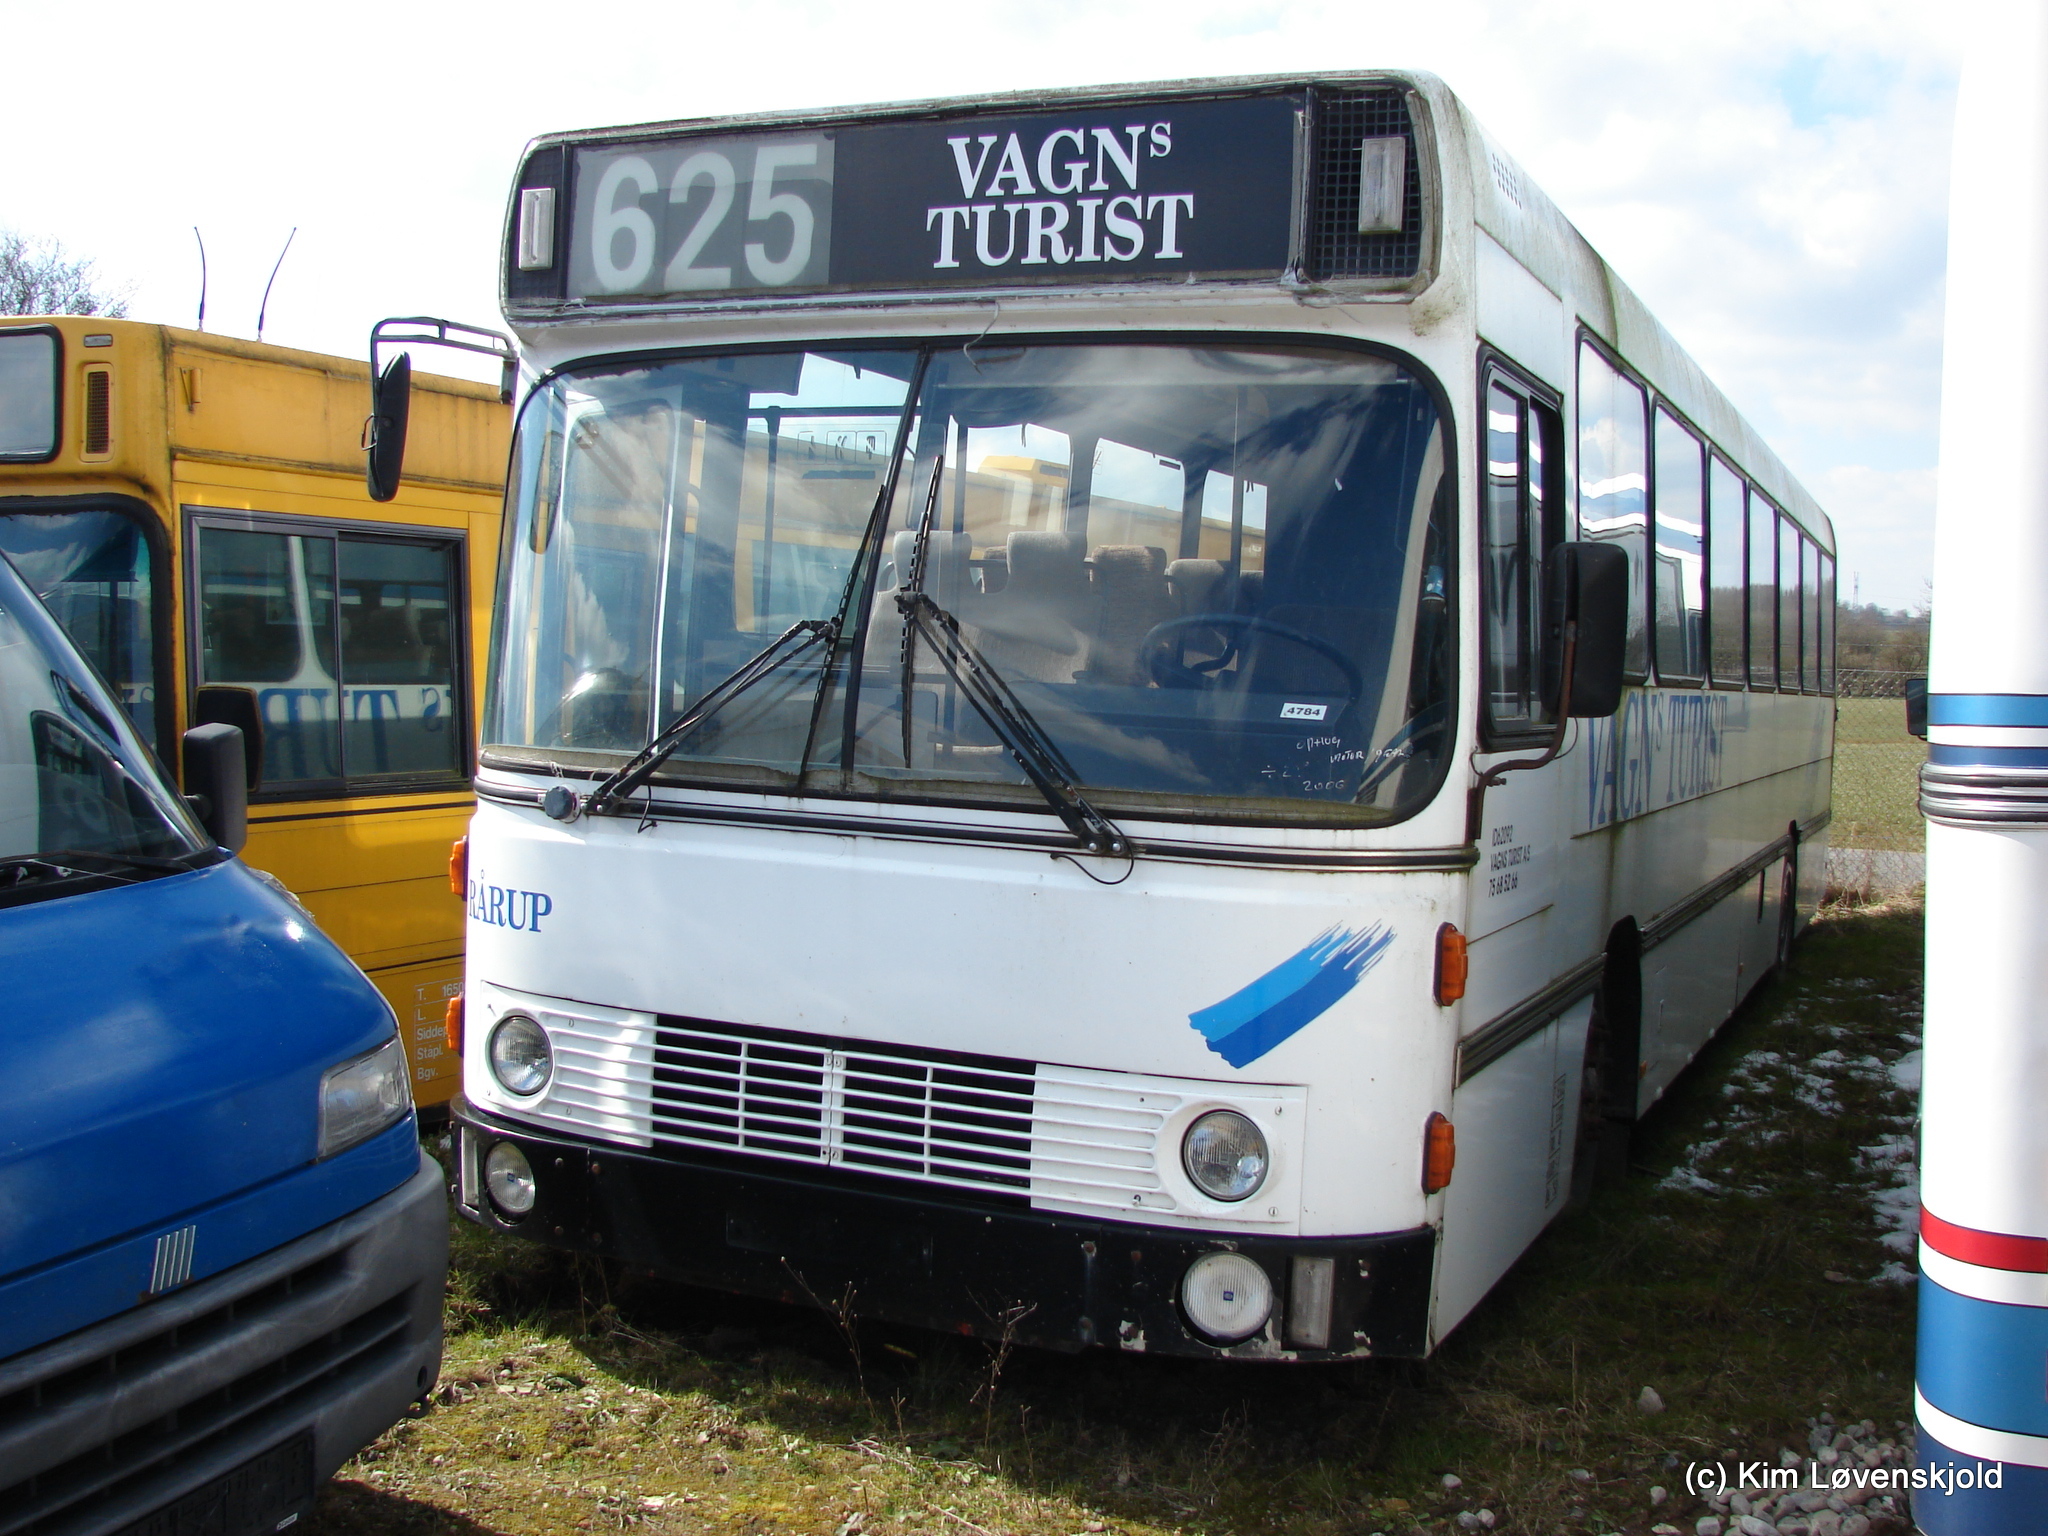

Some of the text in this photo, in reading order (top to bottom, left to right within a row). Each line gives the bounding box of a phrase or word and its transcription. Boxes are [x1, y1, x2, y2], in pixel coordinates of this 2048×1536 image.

[592, 142, 819, 293] 625
[925, 193, 1195, 269] TURIST
[1286, 706, 1321, 717] 4784
[1666, 694, 1728, 803] TURIST
[1302, 780, 1345, 792] 2006
[1507, 846, 1523, 867] TURIST
[468, 868, 553, 933] RÅRUP
[417, 1066, 439, 1081] Bgv.
